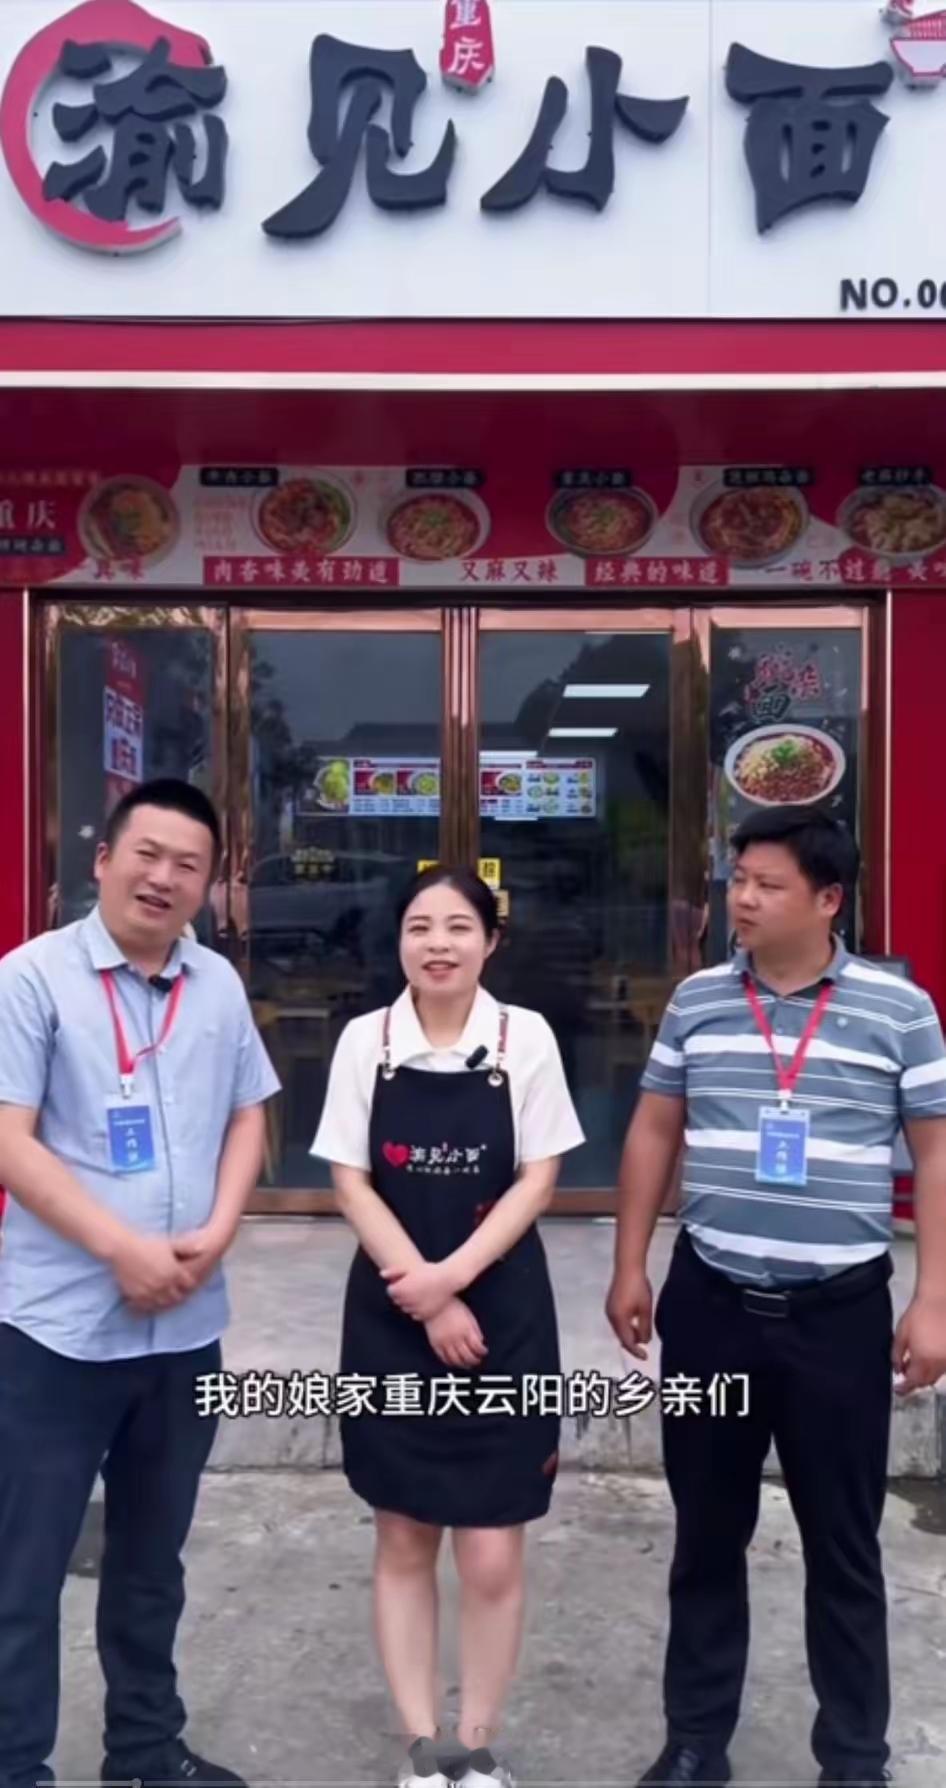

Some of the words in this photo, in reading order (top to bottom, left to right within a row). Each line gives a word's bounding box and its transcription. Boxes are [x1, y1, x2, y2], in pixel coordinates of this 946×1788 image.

[447, 0, 486, 74] 重庆
[42, 34, 894, 239] 渝见小面
[460, 558, 558, 583] 又麻又辣
[594, 558, 721, 584] 经典的味道
